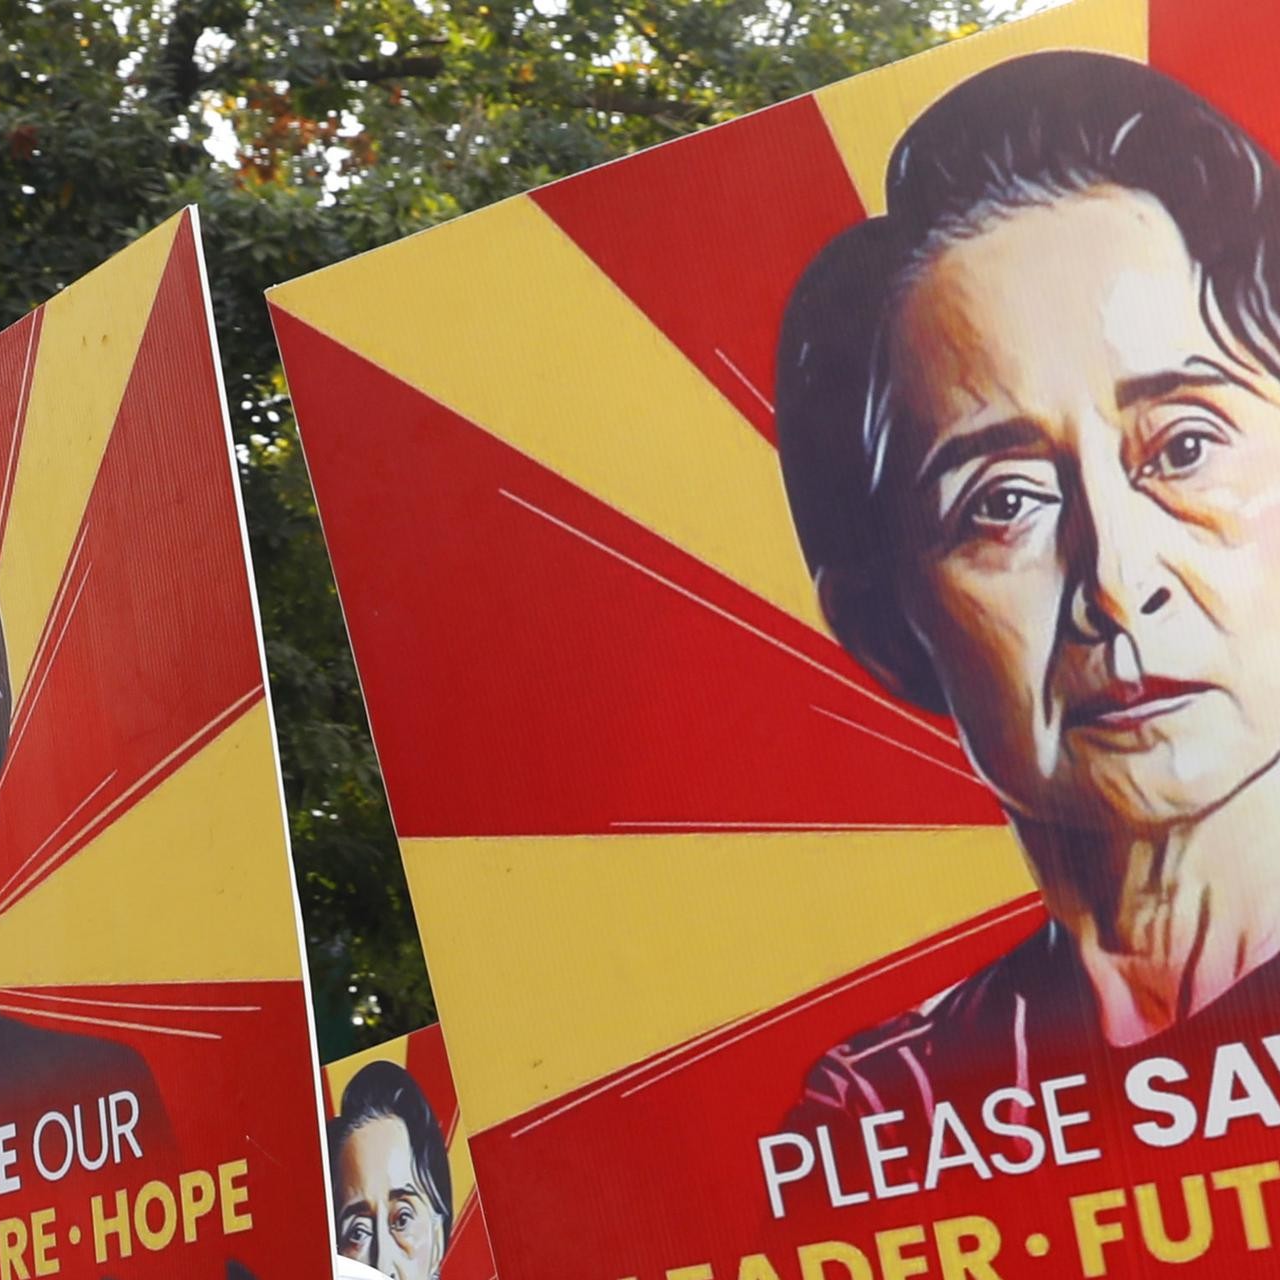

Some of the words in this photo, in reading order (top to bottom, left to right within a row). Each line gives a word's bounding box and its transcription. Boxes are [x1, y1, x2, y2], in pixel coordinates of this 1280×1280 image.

[33, 1090, 143, 1181] OUR
[757, 1074, 1101, 1219] PLEASE
[91, 1158, 253, 1263] HOPE
